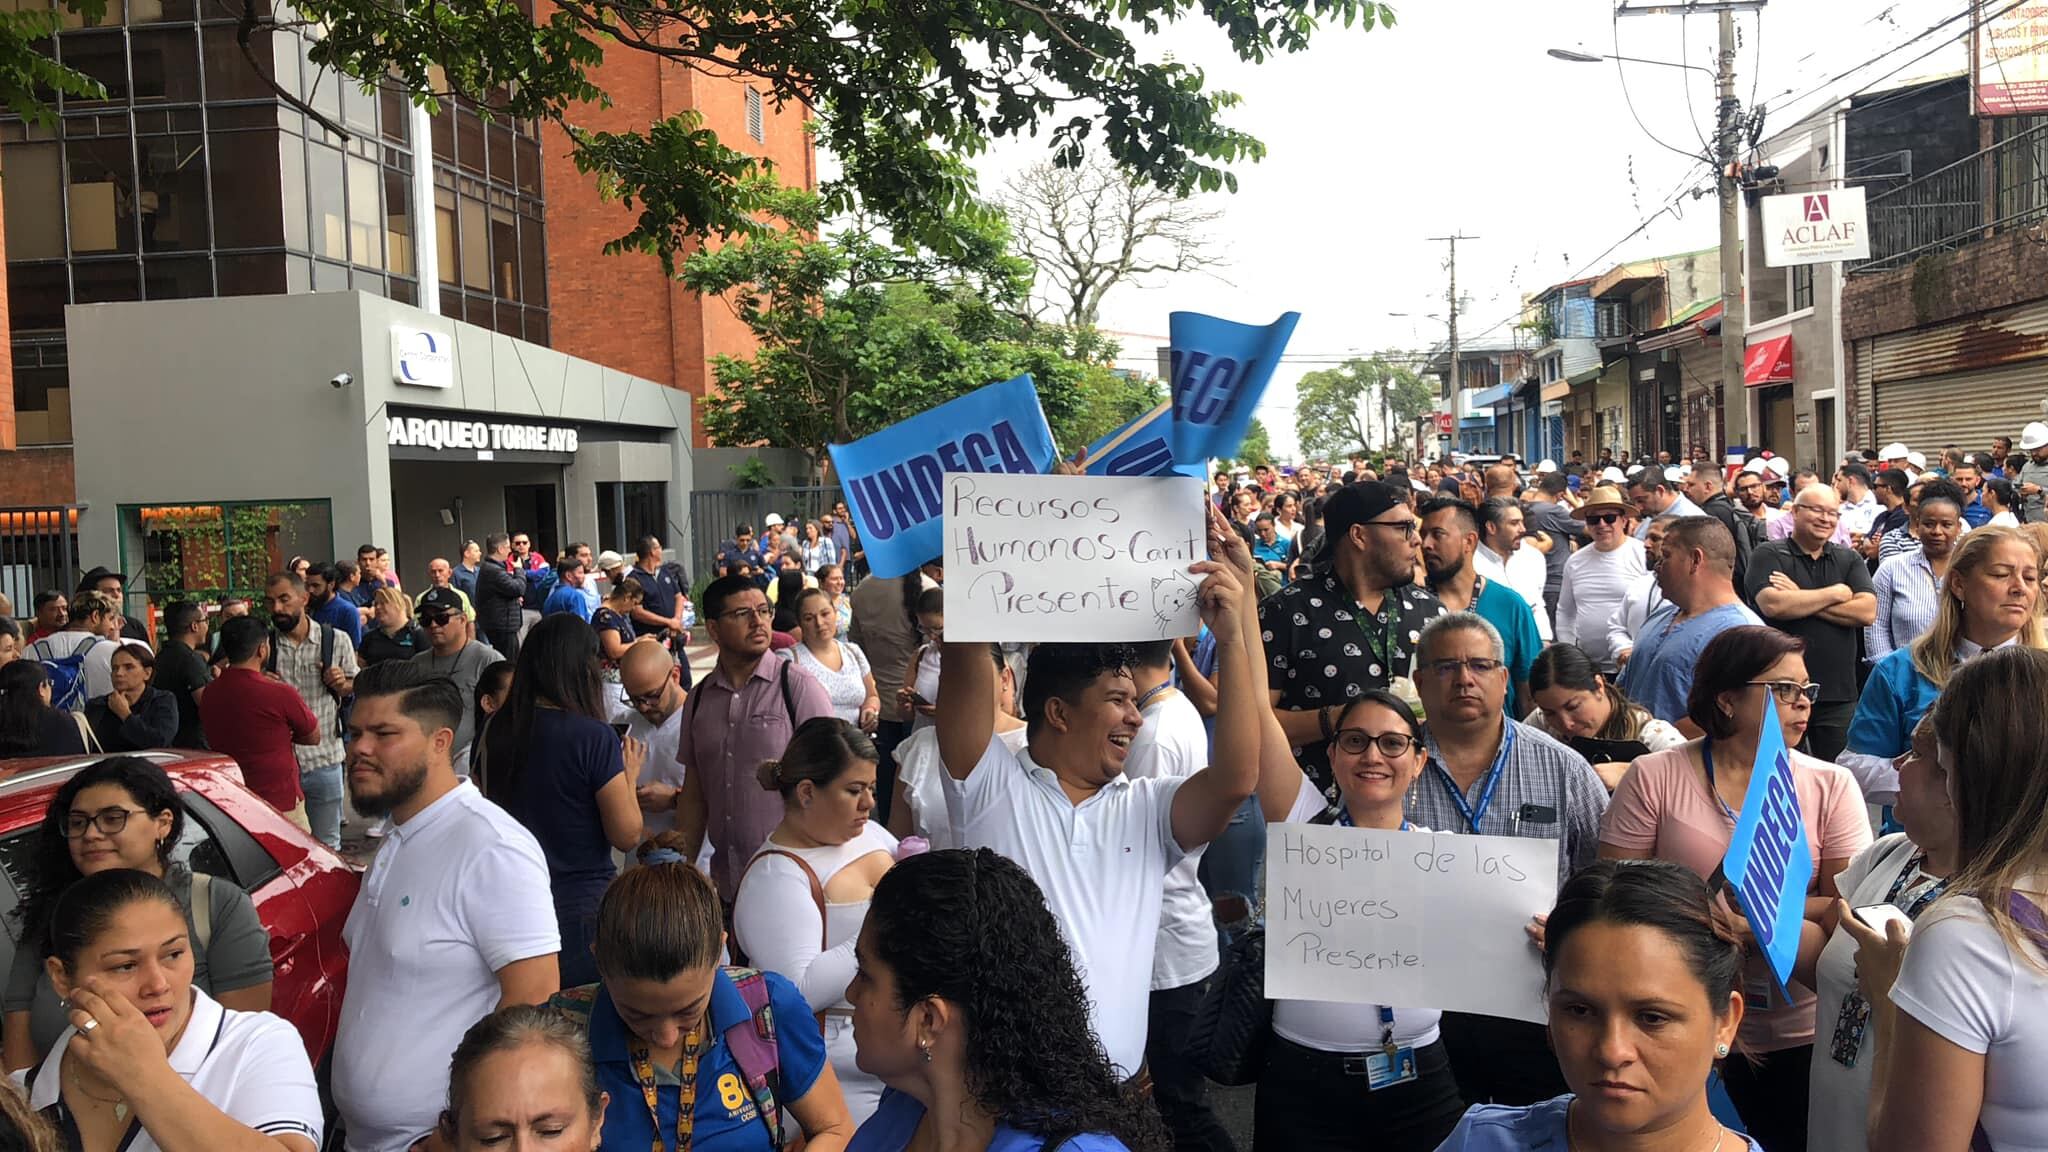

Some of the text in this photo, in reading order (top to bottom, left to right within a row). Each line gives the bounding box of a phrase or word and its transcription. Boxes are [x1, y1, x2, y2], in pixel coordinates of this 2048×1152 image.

[1782, 222, 1856, 246] ACLAF
[490, 424, 548, 450] TORRE
[549, 428, 578, 452] AYB
[950, 476, 1120, 523] Recursos
[968, 570, 1140, 614] Presente
[1284, 832, 1527, 881] Hospital de las
[1283, 886, 1399, 927] Mujeres
